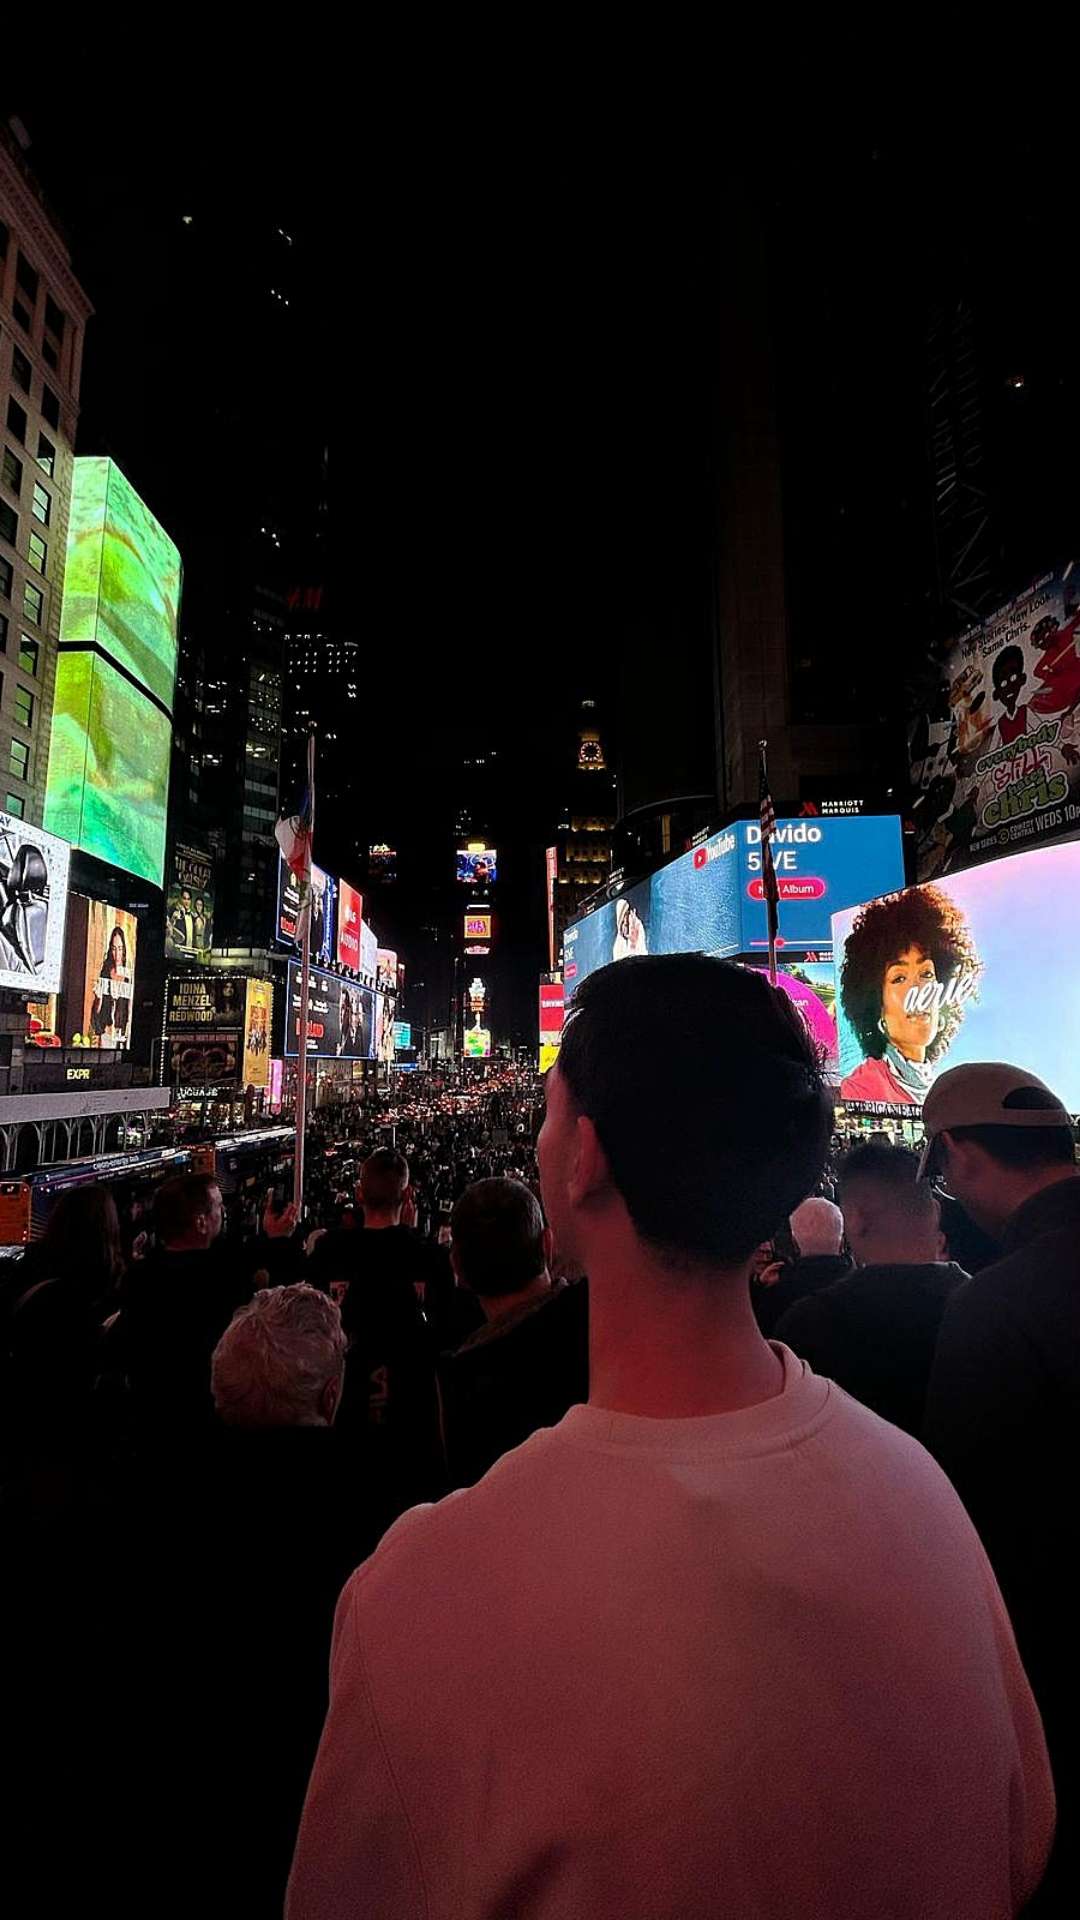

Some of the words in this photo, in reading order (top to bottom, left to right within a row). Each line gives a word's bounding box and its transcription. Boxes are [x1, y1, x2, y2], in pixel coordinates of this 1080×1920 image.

[821, 800, 864, 808] MARRIOTT
[1035, 808, 1062, 832] WEDS
[747, 851, 797, 871] 5VE
[782, 884, 814, 894] Album
[179, 982, 207, 995] IDINA
[904, 965, 973, 1013] aerie
[172, 994, 212, 1007] MENZEL
[168, 1010, 213, 1022] REDWOOD
[66, 1068, 90, 1080] EXPR
